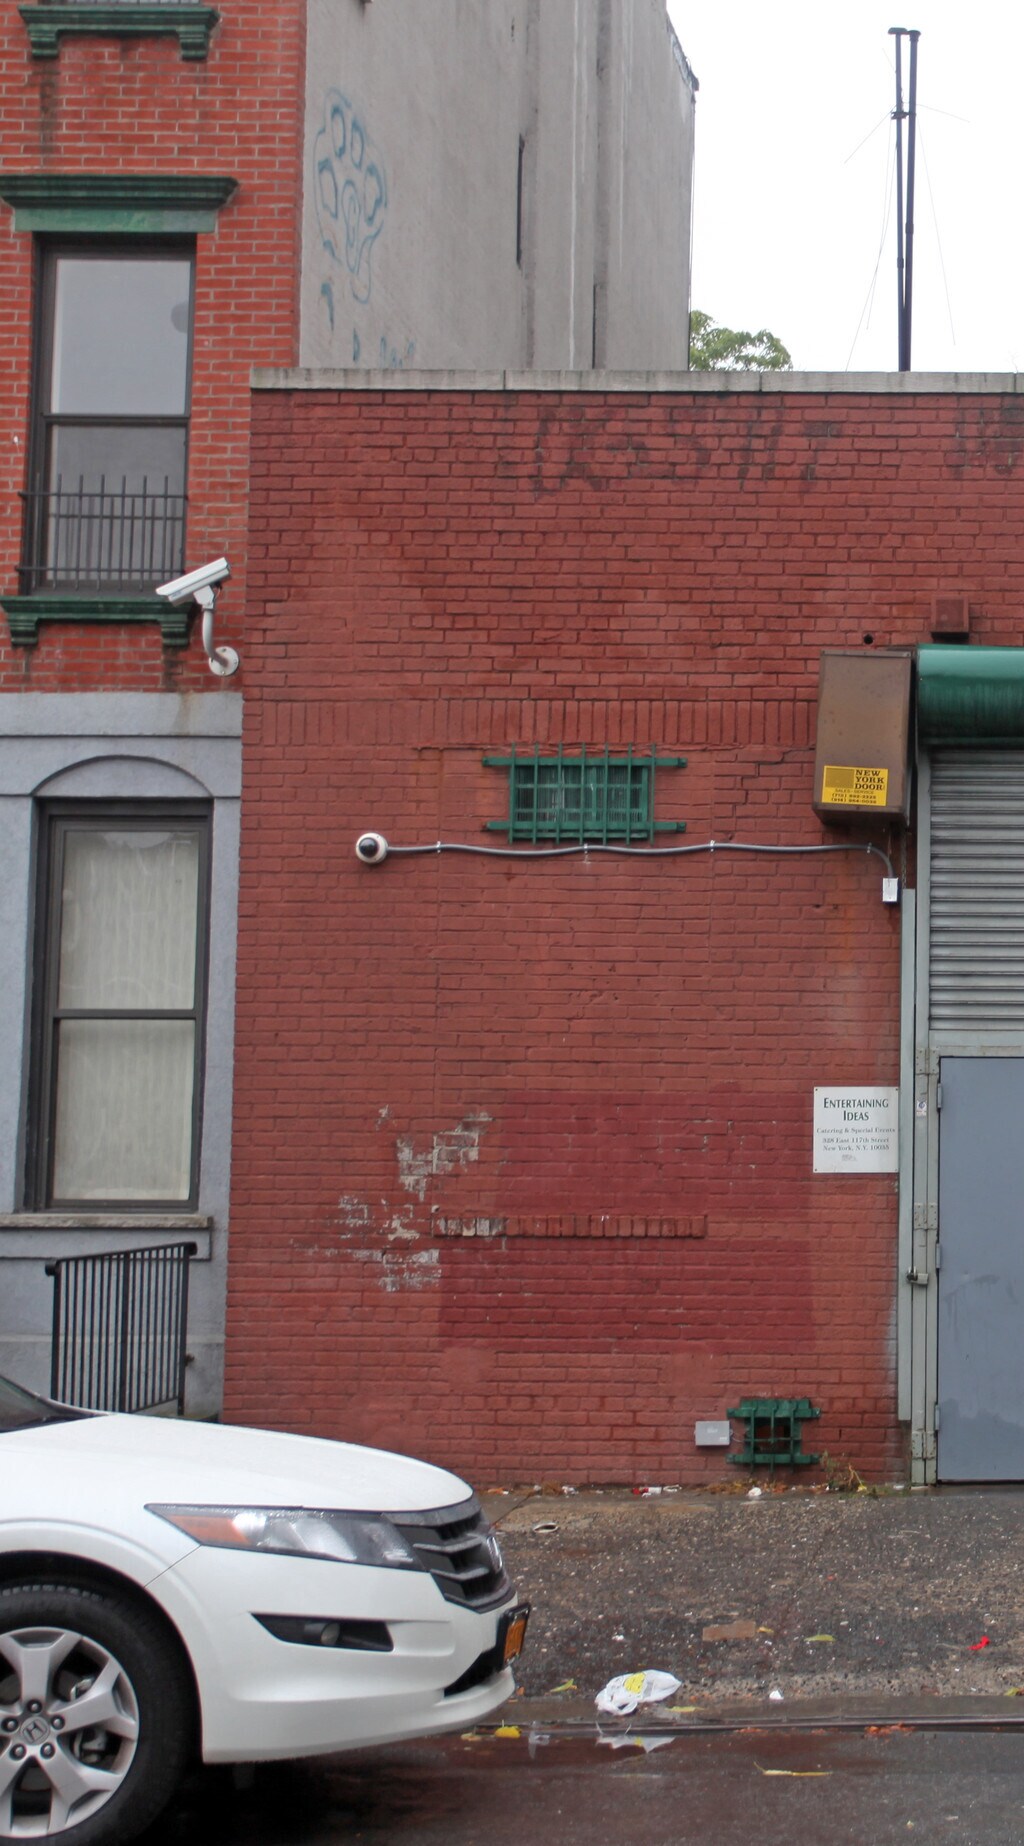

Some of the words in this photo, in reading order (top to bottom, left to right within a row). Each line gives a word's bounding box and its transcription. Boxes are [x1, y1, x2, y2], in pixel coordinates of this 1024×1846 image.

[855, 776, 885, 784] YORK
[823, 1097, 889, 1108] ENTERTAINING
[843, 1110, 870, 1121] IDEAS
